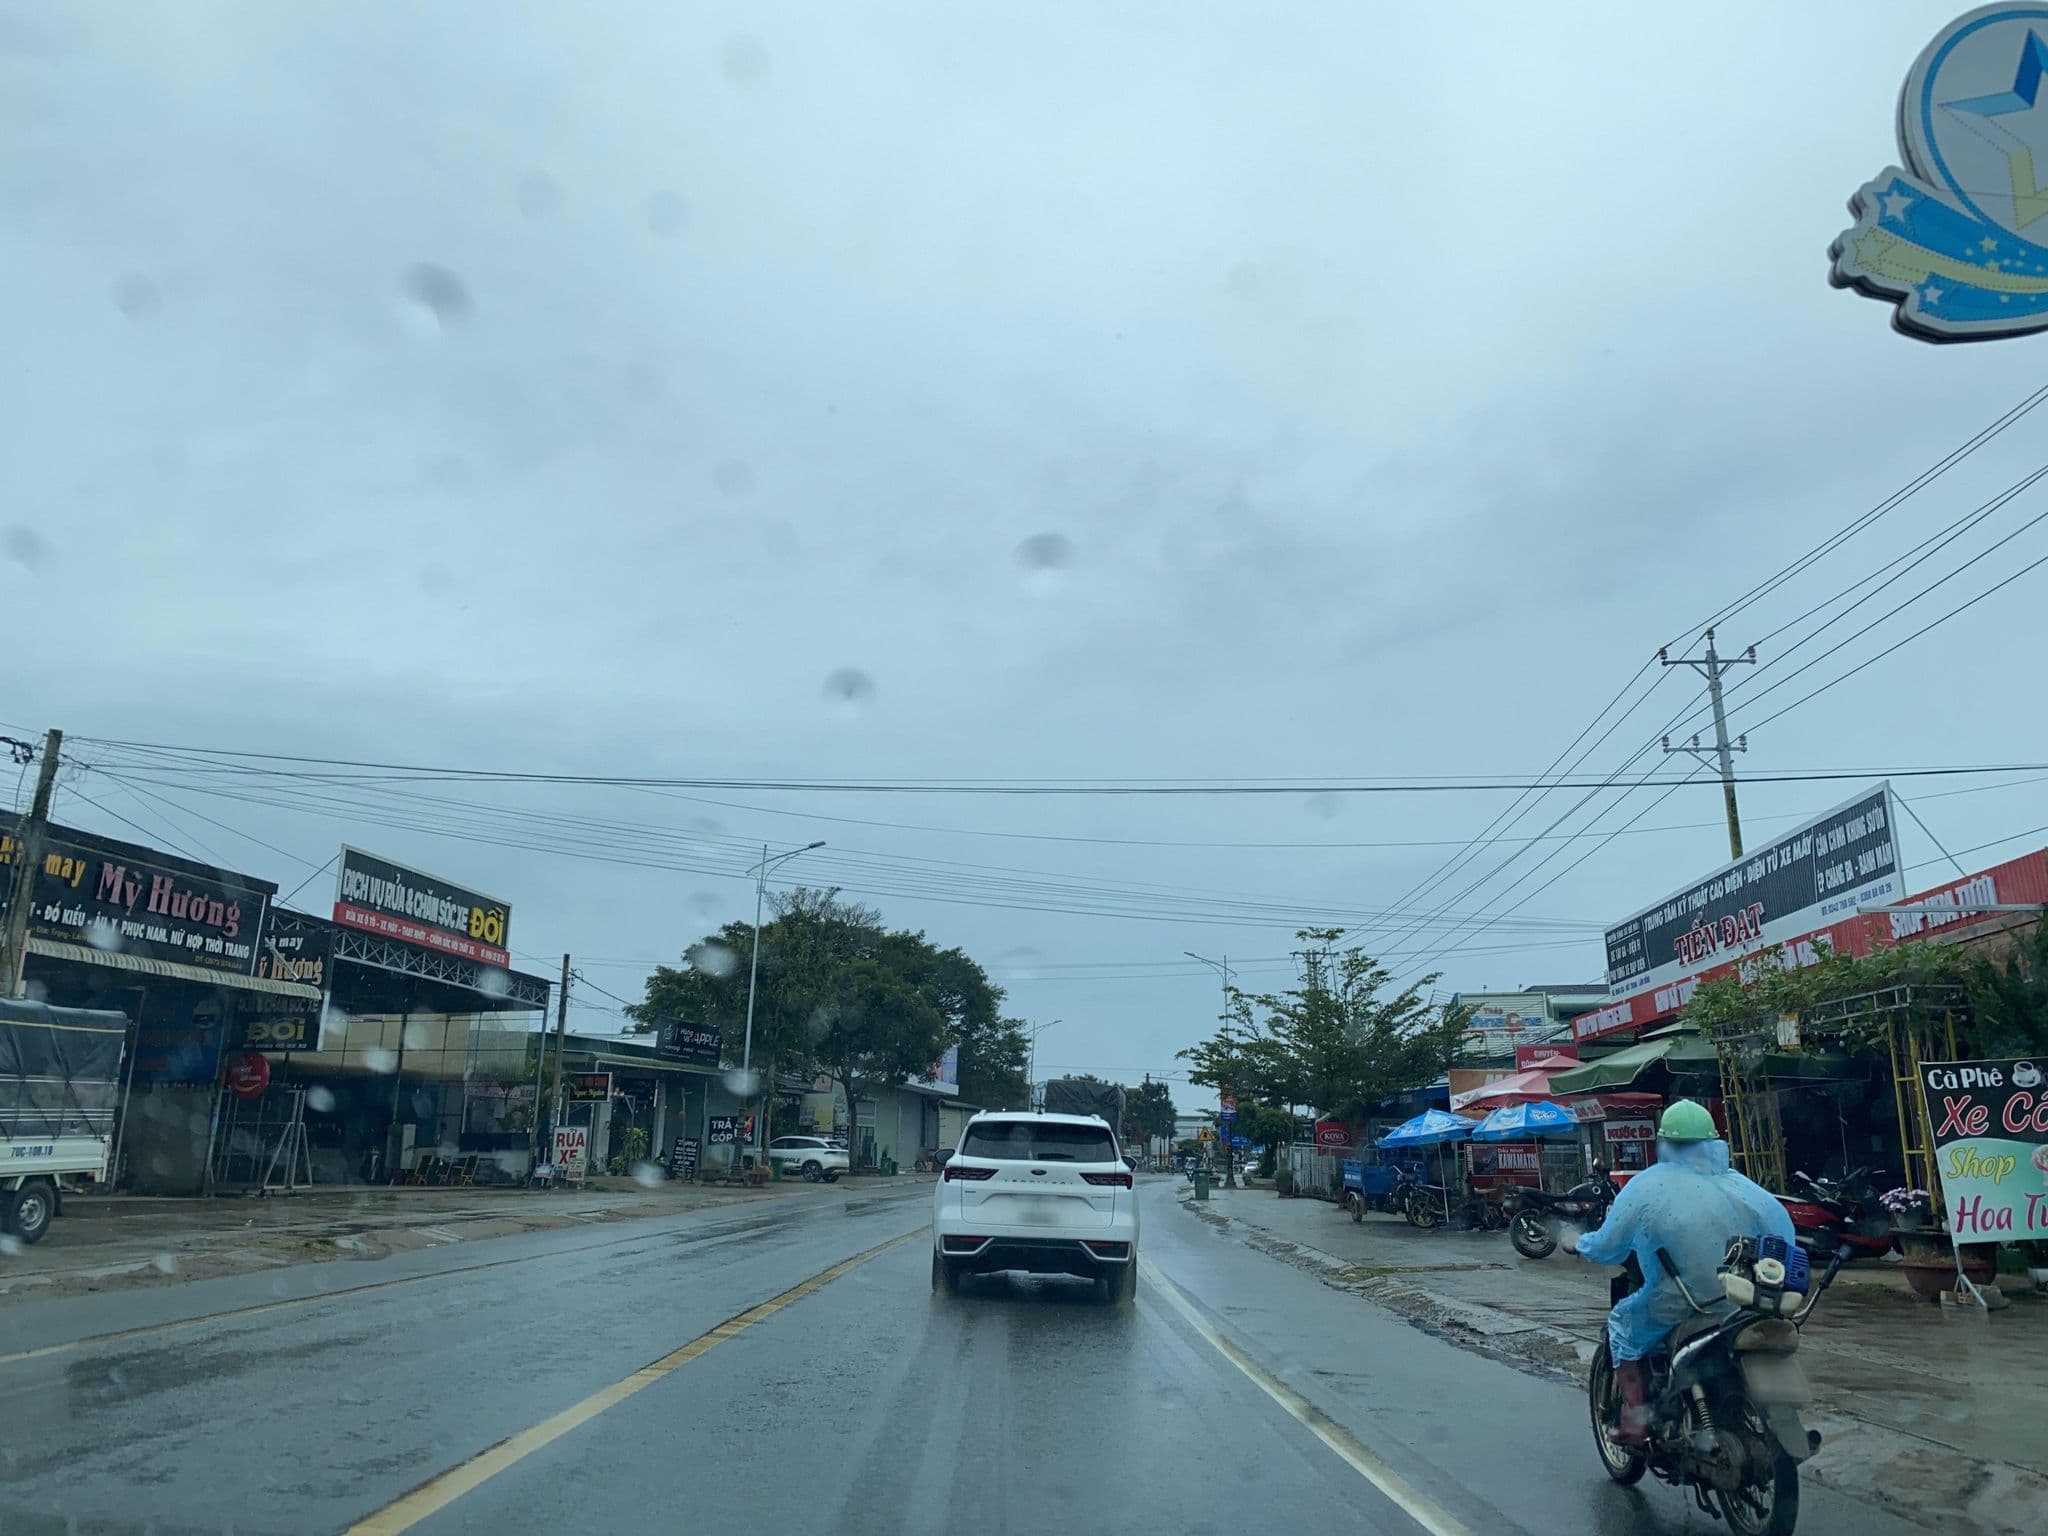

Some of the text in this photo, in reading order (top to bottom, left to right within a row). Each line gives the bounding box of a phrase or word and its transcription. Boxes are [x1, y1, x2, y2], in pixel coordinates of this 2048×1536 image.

[45, 854, 241, 937] may Mỹ Hương
[342, 867, 369, 902] DỊCH
[370, 876, 386, 911] VỤ
[384, 873, 406, 913] RỬA
[406, 887, 414, 915] &
[413, 887, 440, 924] CHĂM
[438, 896, 457, 928] SÓC
[456, 905, 470, 931] XE
[1644, 910, 1664, 933] TRUNG
[1664, 903, 1677, 924] TÂM
[1724, 870, 1743, 895] ĐIỆN
[1746, 857, 1765, 884] ĐIỆN
[1780, 845, 1792, 868] XE
[1792, 832, 1812, 862] MÁY
[121, 920, 145, 940] PHỤC
[205, 936, 224, 955] THỜI
[225, 942, 250, 959] TRANG
[279, 937, 304, 951] may
[694, 1032, 720, 1047] APPLE
[1927, 1067, 2004, 1090] Cà Phê
[712, 1117, 732, 1129] TRẢ
[1937, 1094, 1989, 1137] Xe
[556, 1128, 585, 1148] RỬA
[1323, 1132, 1345, 1140] KOVA
[1947, 1147, 2016, 1185] Shop
[1956, 1195, 2013, 1234] Hoa
